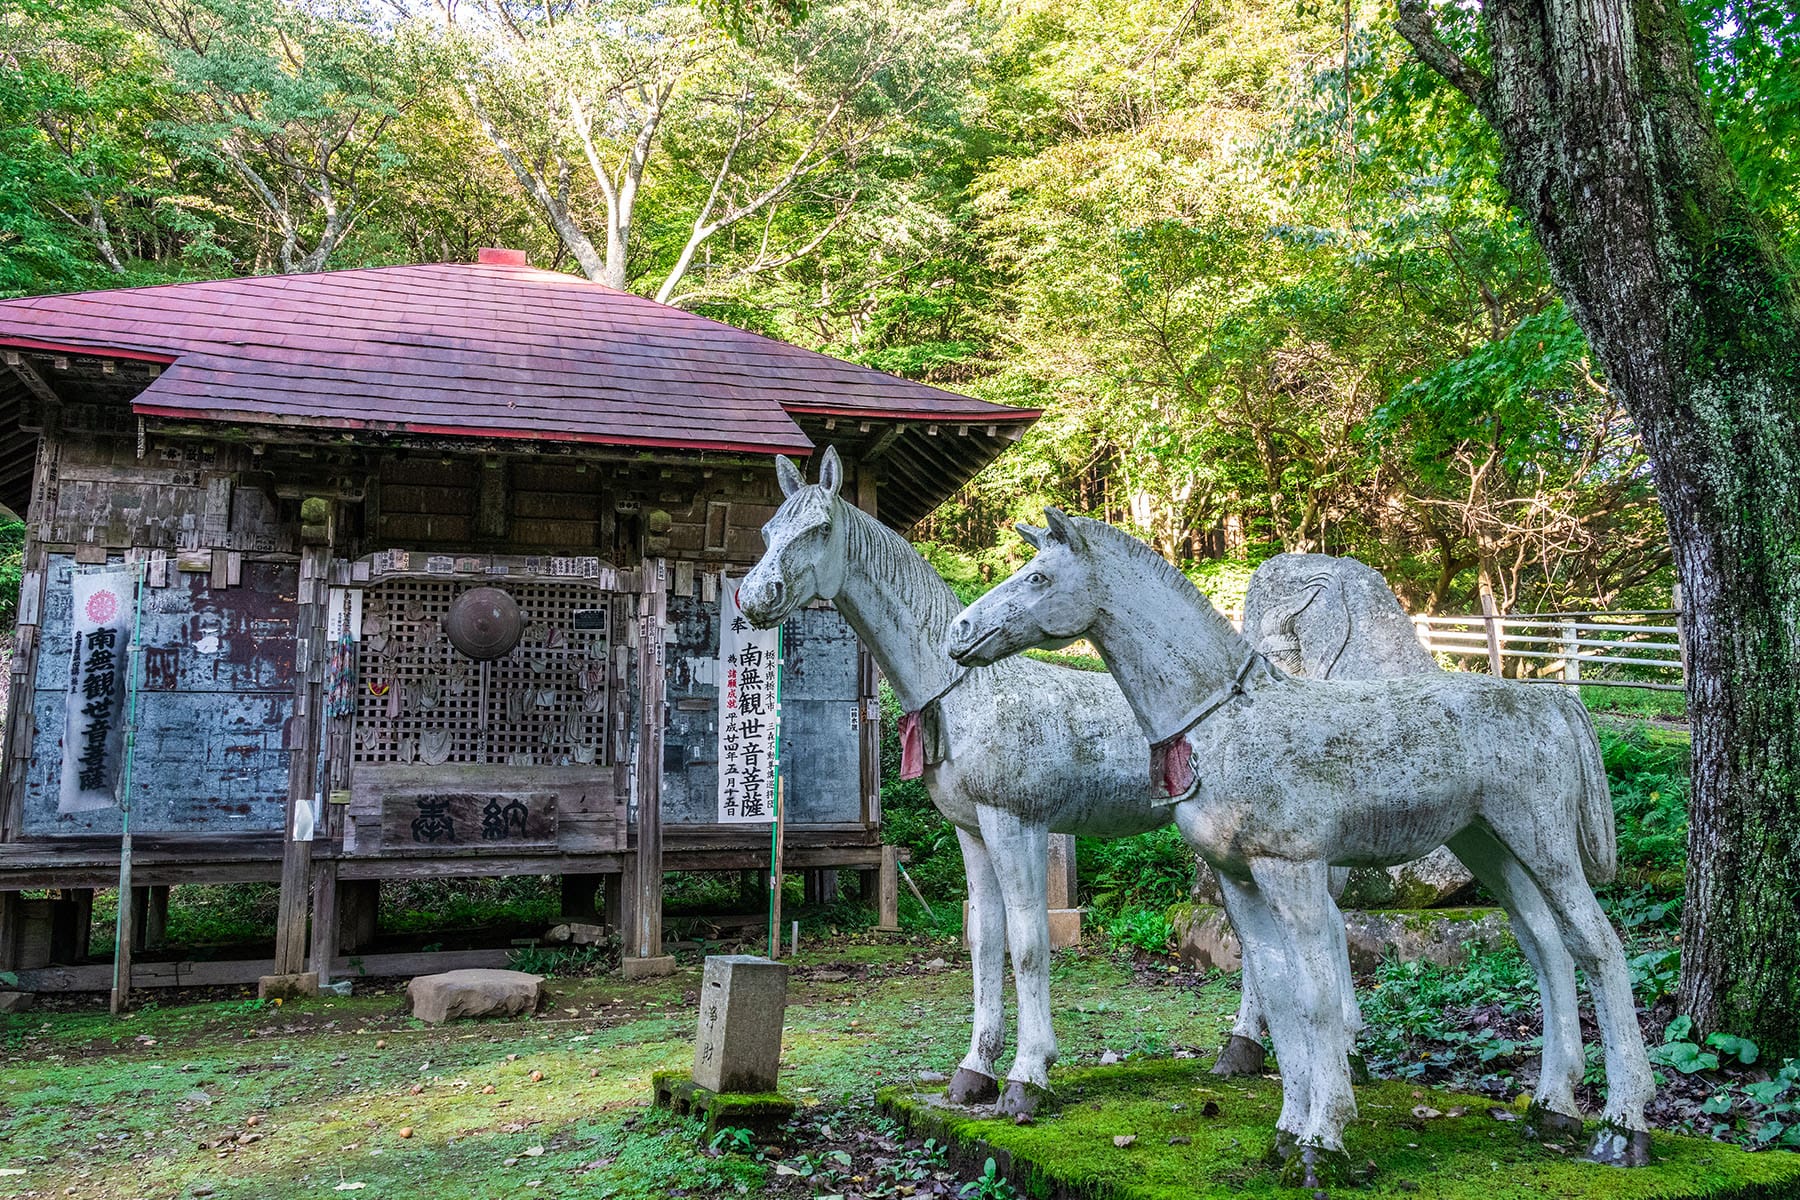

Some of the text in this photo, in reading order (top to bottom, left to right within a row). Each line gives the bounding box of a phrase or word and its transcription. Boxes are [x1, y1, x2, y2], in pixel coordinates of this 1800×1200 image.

[78, 627, 117, 791] 南無観世音菩薩
[726, 668, 738, 709] 諸願成就
[764, 649, 775, 712] 栃木県栃木市
[723, 712, 739, 817] 平成廿四年五月十五日
[738, 642, 765, 817] 南無観世音菩薩
[411, 794, 529, 842] 奉納
